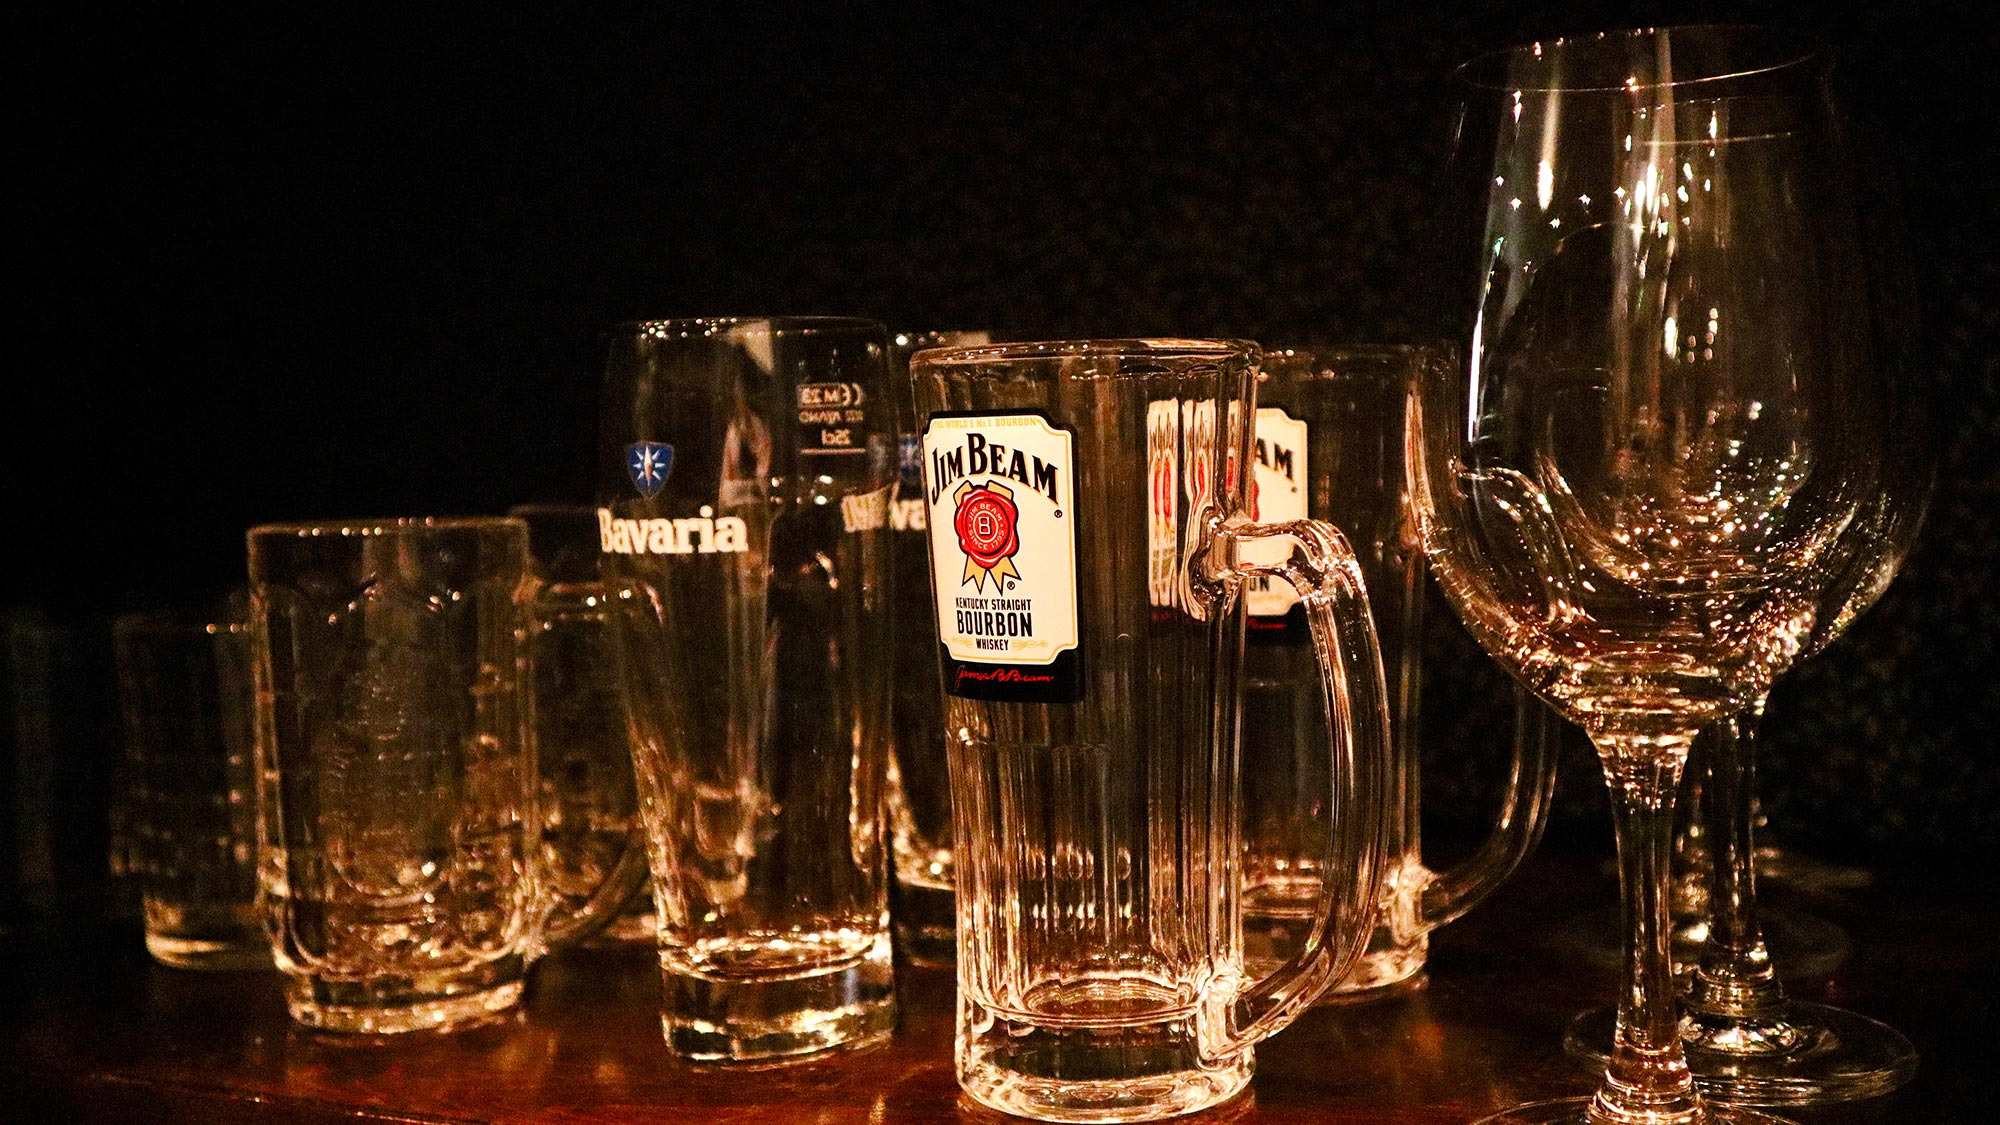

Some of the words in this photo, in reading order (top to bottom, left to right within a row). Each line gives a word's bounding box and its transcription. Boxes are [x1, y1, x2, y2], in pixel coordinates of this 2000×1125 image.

[995, 417, 1037, 427] BOURBON
[931, 446, 965, 506] JIM
[966, 432, 1059, 506] BEAM
[1255, 437, 1295, 482] AM
[968, 506, 979, 520] JIM
[980, 503, 1003, 521] BEAM
[597, 504, 749, 555] Bavaria
[978, 516, 991, 535] B
[968, 530, 989, 550] SINCE
[990, 530, 1005, 549] 1795
[955, 597, 989, 610] KENTUCKY
[991, 598, 1032, 611] STRAIGHT
[956, 610, 1033, 637] BOURBON
[975, 638, 1009, 651] WHISKEY
